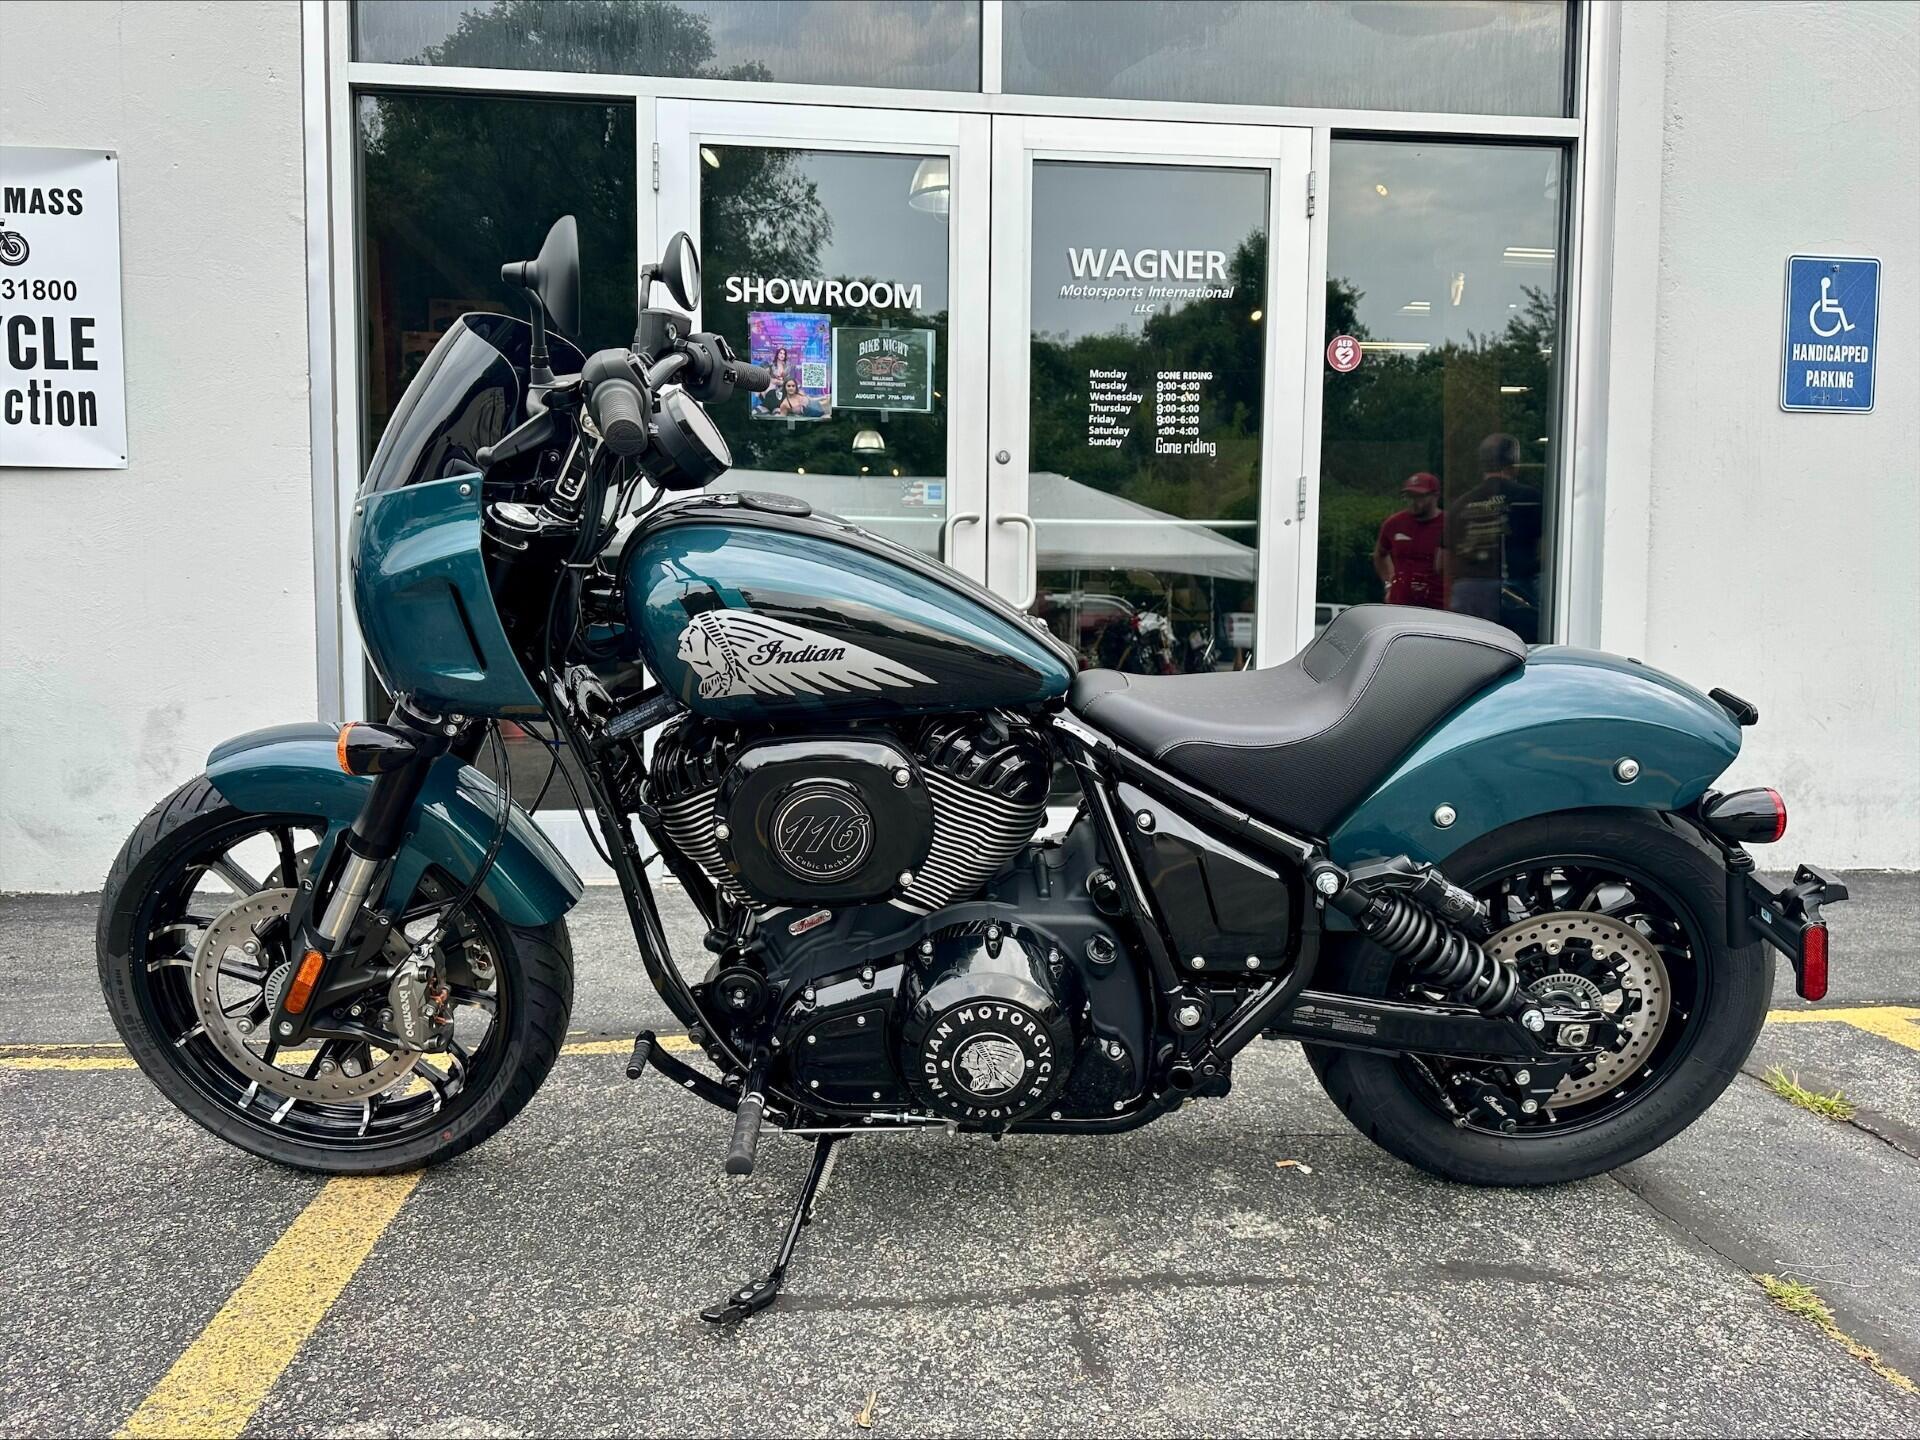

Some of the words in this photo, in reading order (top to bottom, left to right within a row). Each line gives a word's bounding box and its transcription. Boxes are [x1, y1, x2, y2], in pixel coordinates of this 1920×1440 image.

[4, 187, 83, 216] MASS
[1067, 247, 1228, 281] WAGNER
[1, 278, 77, 302] 31800
[725, 276, 922, 309] SHOWROOM
[1059, 284, 1145, 299] Motorsports
[1147, 285, 1236, 299] International
[1134, 303, 1156, 313] LLC
[0, 314, 99, 371] CLE
[859, 338, 880, 356] BIKE
[882, 339, 909, 357] NIGHT
[1337, 339, 1353, 347] AED
[1792, 343, 1869, 364] HANDICAPPED
[1089, 369, 1128, 381] Monday
[1156, 371, 1181, 380] GONE
[1182, 371, 1214, 381] RIDING
[1805, 369, 1855, 389] PARKING
[1089, 380, 1128, 392] Tuesday
[1156, 381, 1200, 392] 9:00-6:00
[4, 379, 98, 427] ction
[1089, 391, 1144, 404] Wednesday
[1089, 403, 1132, 415] Thursday
[1156, 403, 1200, 414] 9:00-6:00
[1088, 414, 1117, 426] Friday
[1088, 425, 1130, 437] Saturday
[1088, 436, 1123, 449] Sunday
[1155, 436, 1182, 454] Gone
[1184, 438, 1217, 457] riding
[749, 640, 847, 666] Indian
[781, 814, 871, 853] 116
[796, 855, 820, 870] Cubic
[823, 855, 852, 871] Inches
[399, 990, 416, 1038] brembo
[925, 1022, 953, 1099] INDIAN
[958, 1006, 1052, 1098] MOTORCYCLE
